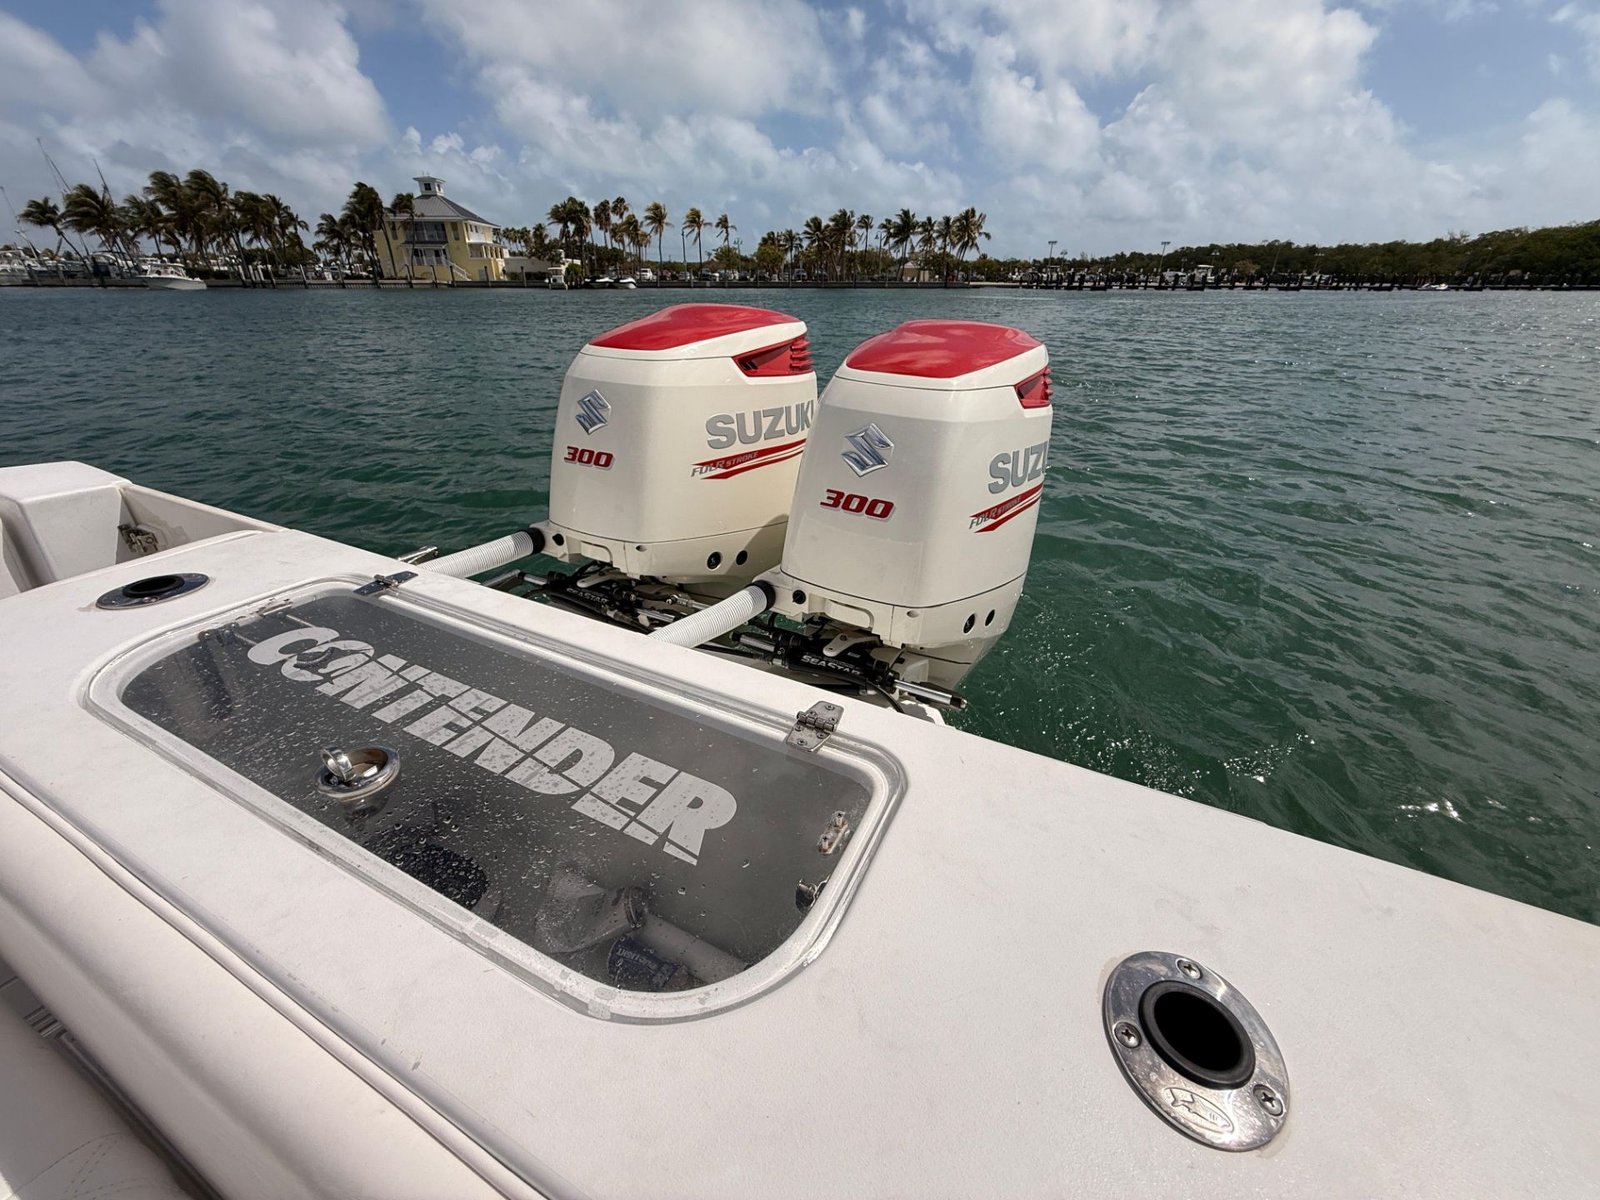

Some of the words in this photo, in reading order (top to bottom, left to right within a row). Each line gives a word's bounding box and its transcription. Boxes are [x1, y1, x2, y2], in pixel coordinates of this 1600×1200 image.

[705, 400, 815, 450] SUZUKI
[564, 446, 615, 471] 300
[690, 460, 725, 478] FOUR
[820, 489, 896, 521] 300
[247, 627, 738, 866] CONTENDER
